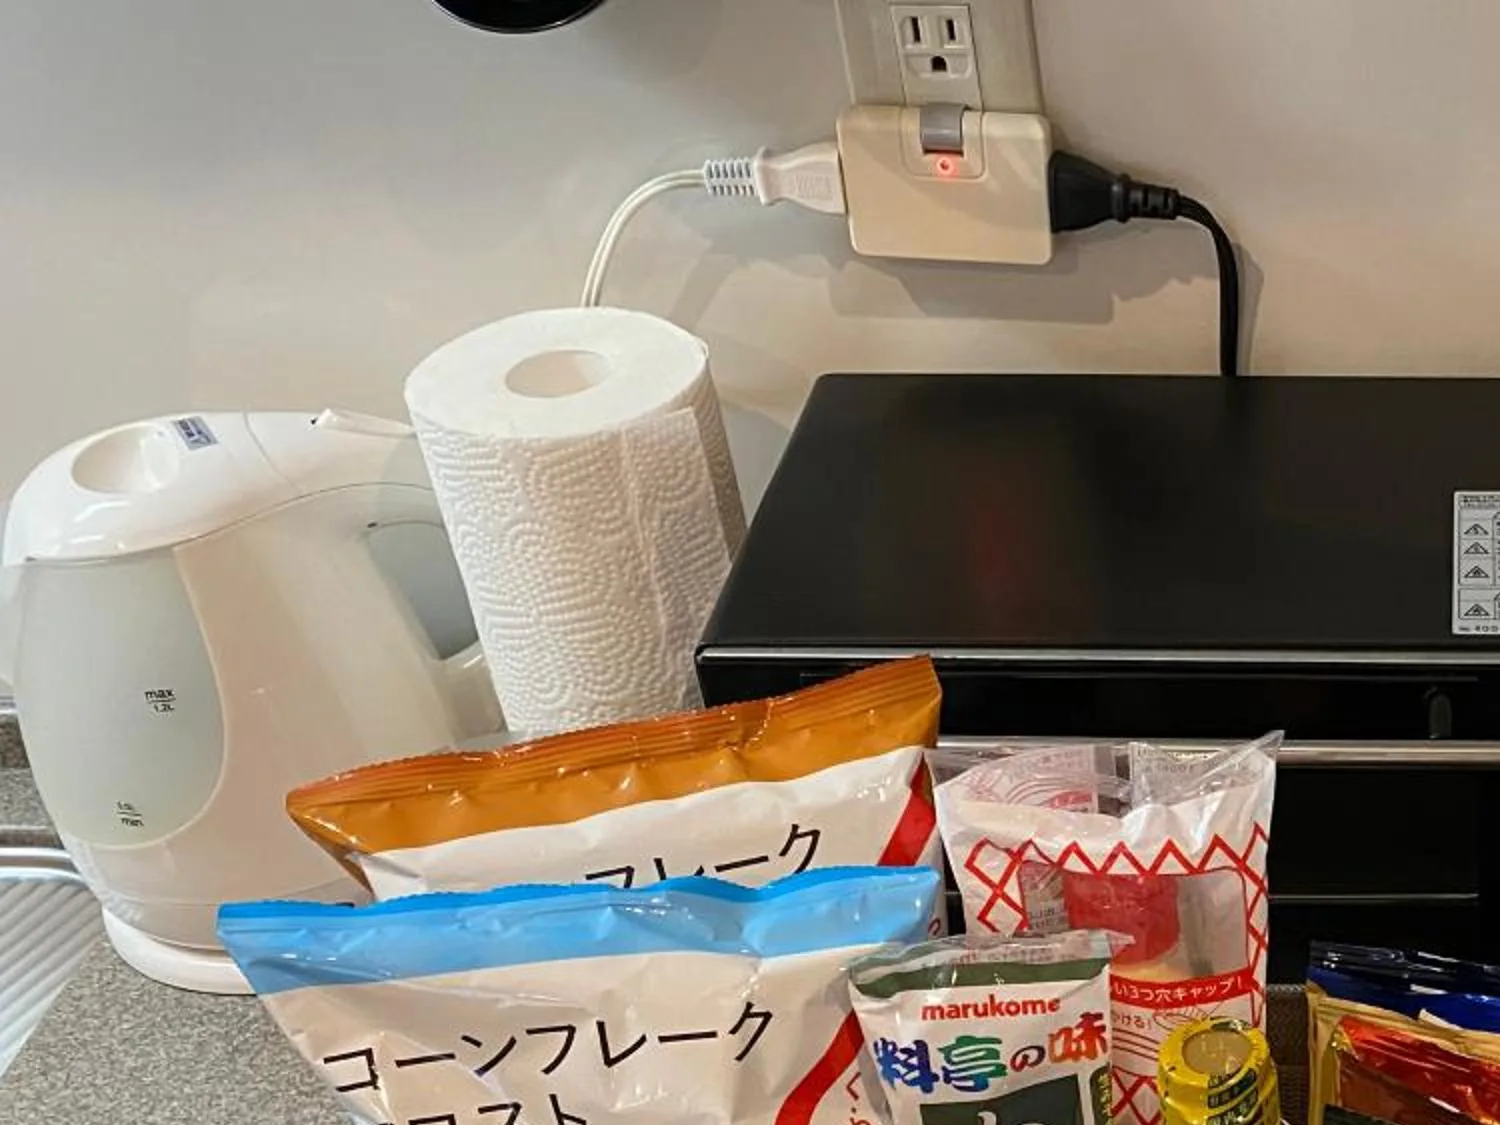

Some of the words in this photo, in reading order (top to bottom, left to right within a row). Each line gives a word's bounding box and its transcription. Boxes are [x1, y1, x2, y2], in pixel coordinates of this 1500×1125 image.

[145, 689, 174, 699] max
[1112, 974, 1244, 1003] い3つ穴キャップ!
[921, 995, 1060, 1021] marukome
[323, 1002, 773, 1092] コーンフレーク
[873, 1012, 1107, 1094] 料亭の味
